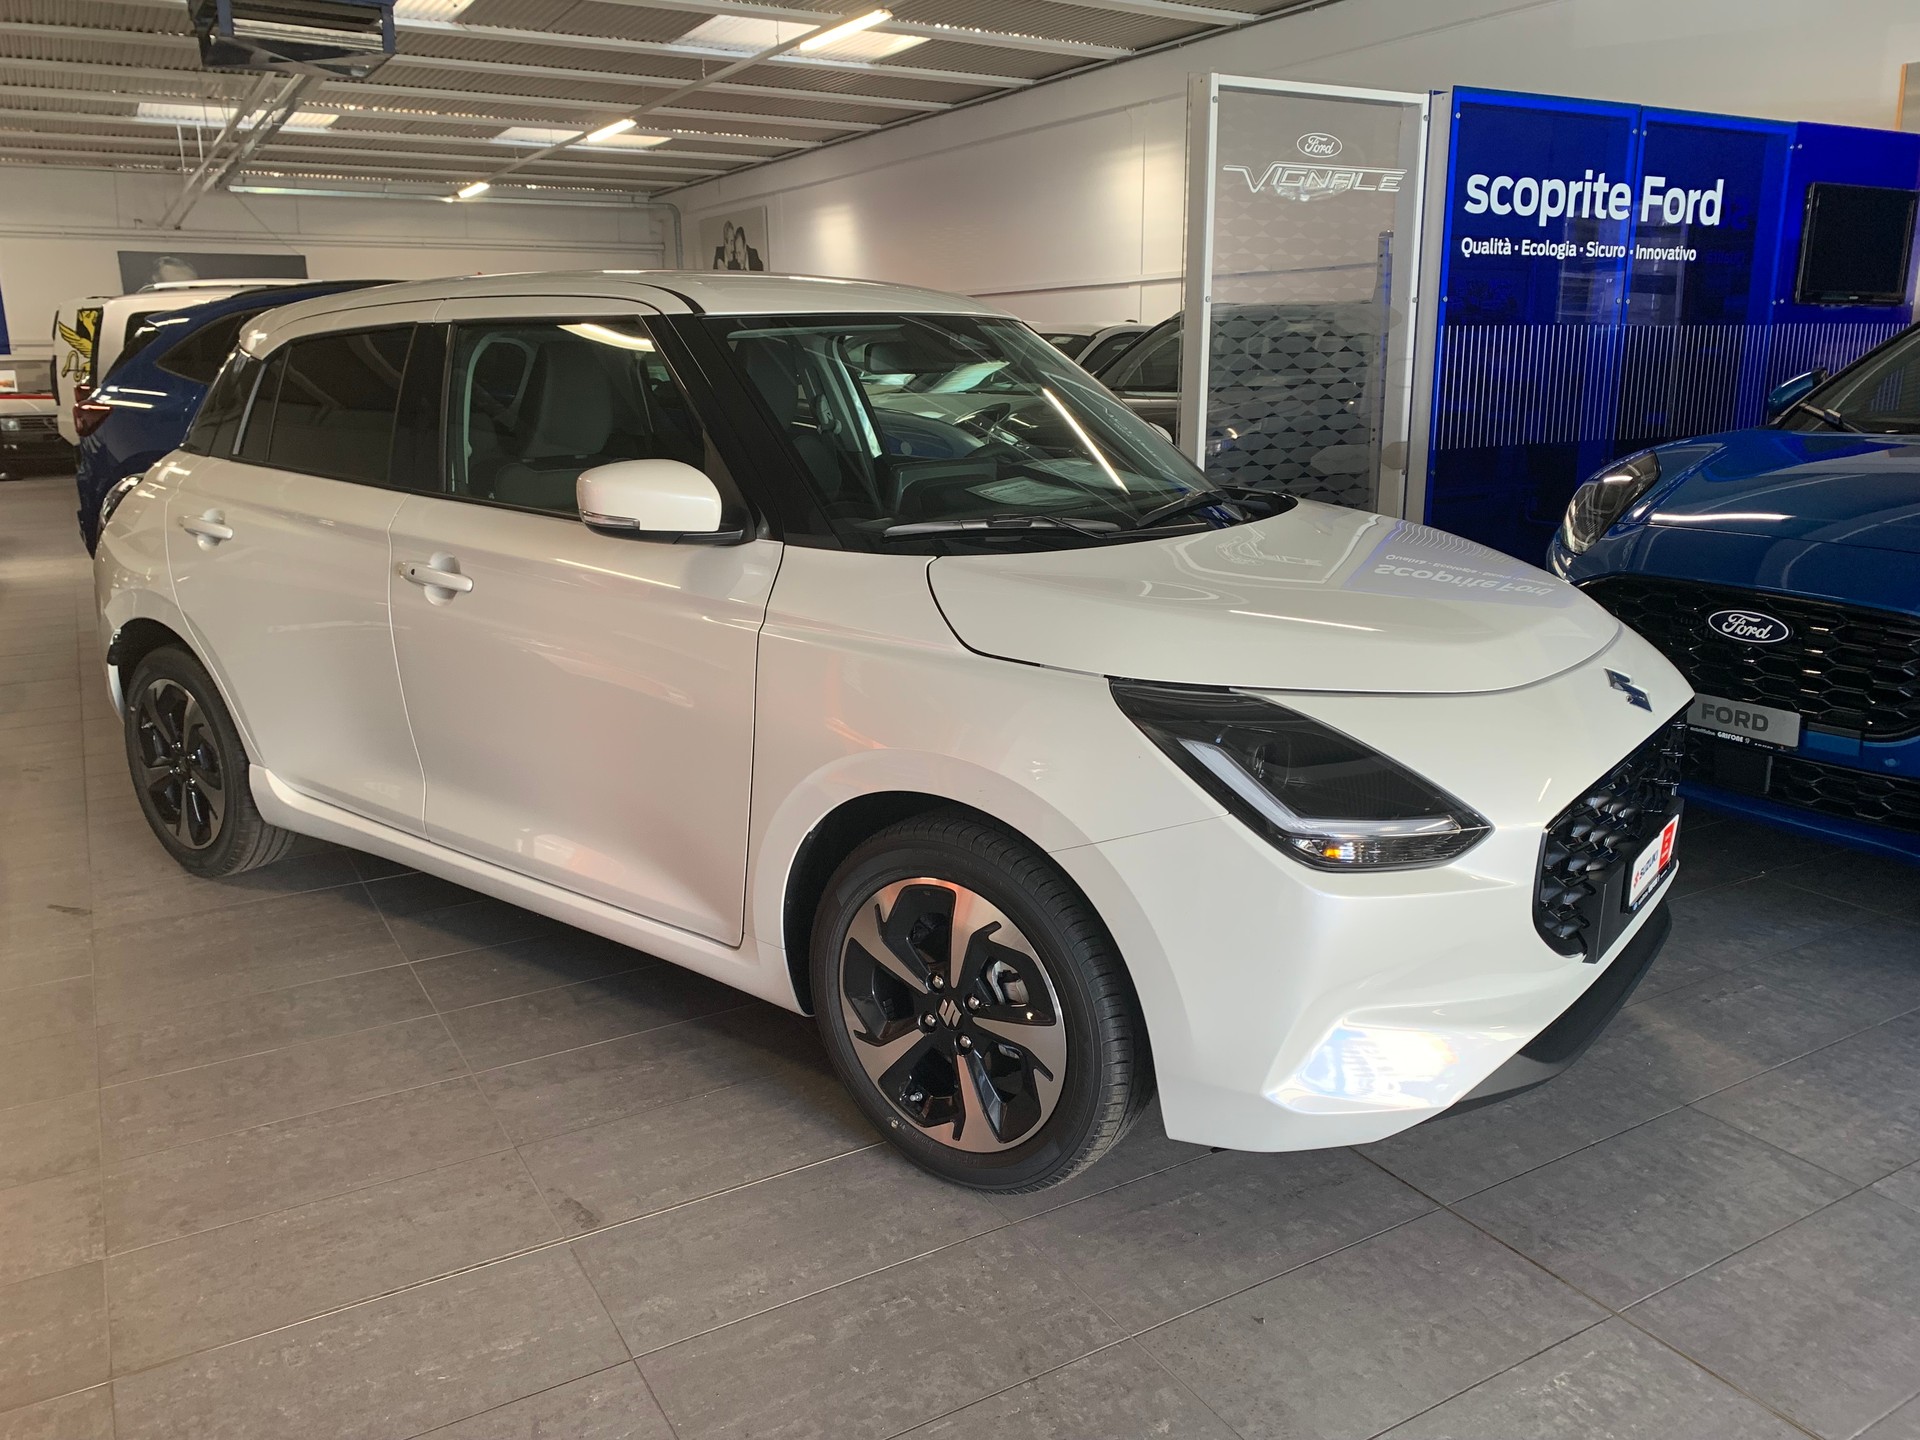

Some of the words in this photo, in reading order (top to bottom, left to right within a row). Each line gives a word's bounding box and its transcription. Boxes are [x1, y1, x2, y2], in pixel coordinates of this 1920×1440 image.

[1303, 134, 1336, 155] Ford
[1222, 161, 1408, 193] VIGNALE
[1464, 169, 1632, 227] scoprite
[1640, 175, 1725, 226] Ford
[1461, 237, 1511, 257] Qualità
[1521, 239, 1577, 260] Ecologia
[1585, 241, 1626, 258] Sicuro
[1635, 244, 1697, 261] Innovativo
[1720, 613, 1774, 640] Ford
[1701, 703, 1769, 732] FORD
